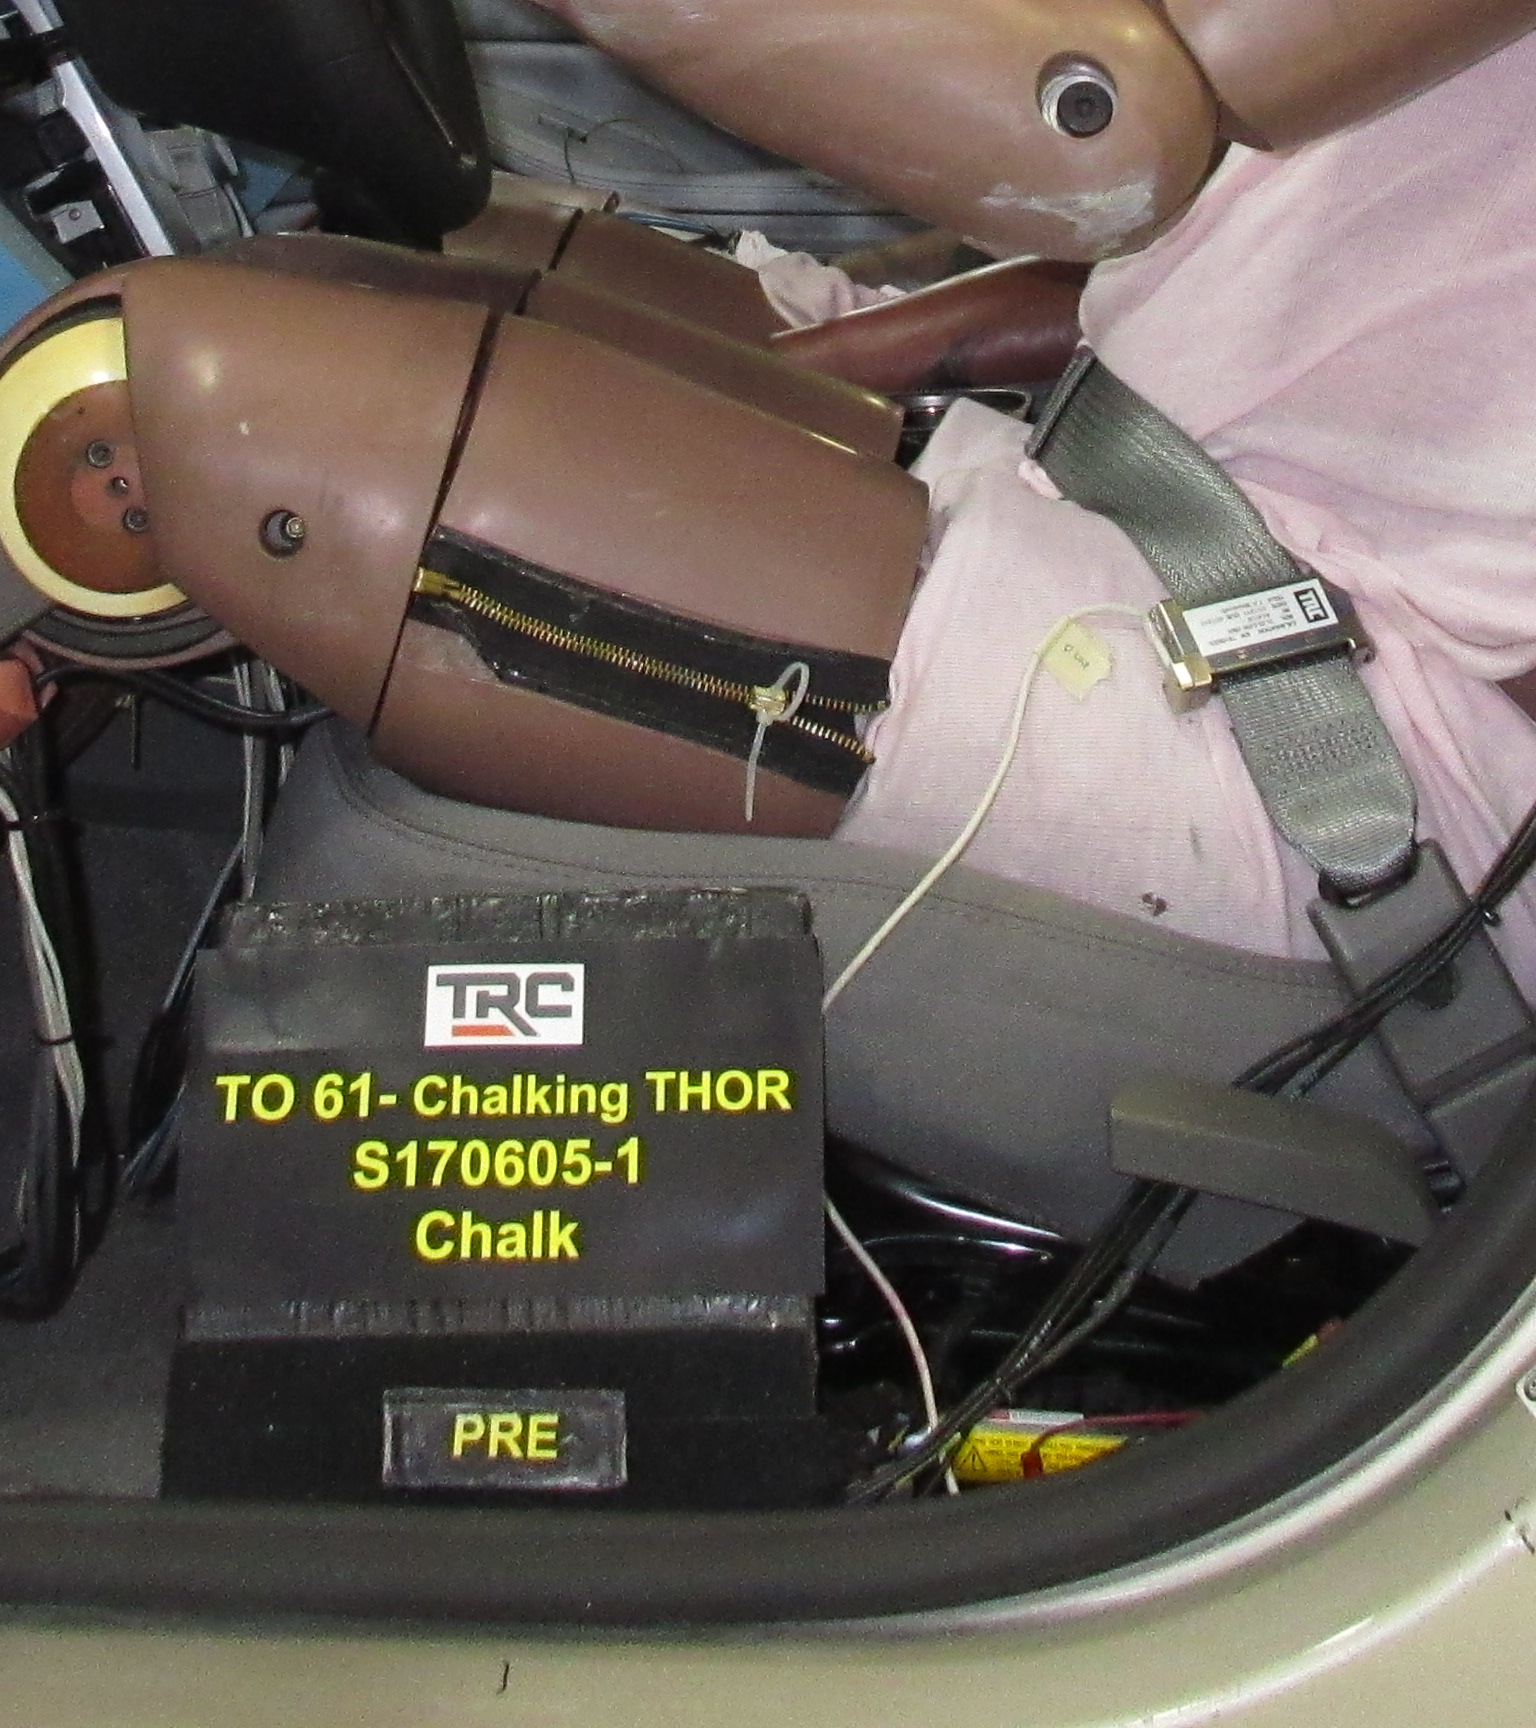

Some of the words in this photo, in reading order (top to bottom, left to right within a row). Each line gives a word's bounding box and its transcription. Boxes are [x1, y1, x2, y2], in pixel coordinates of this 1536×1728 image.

[434, 971, 576, 1038] TRC
[215, 1074, 296, 1123] TO
[311, 1073, 397, 1121] 61-
[412, 1075, 629, 1124] Chalking
[646, 1070, 792, 1113] THOR
[352, 1138, 640, 1190] S170605-1
[414, 1210, 580, 1261] Chalk
[452, 1415, 556, 1459] PRE
